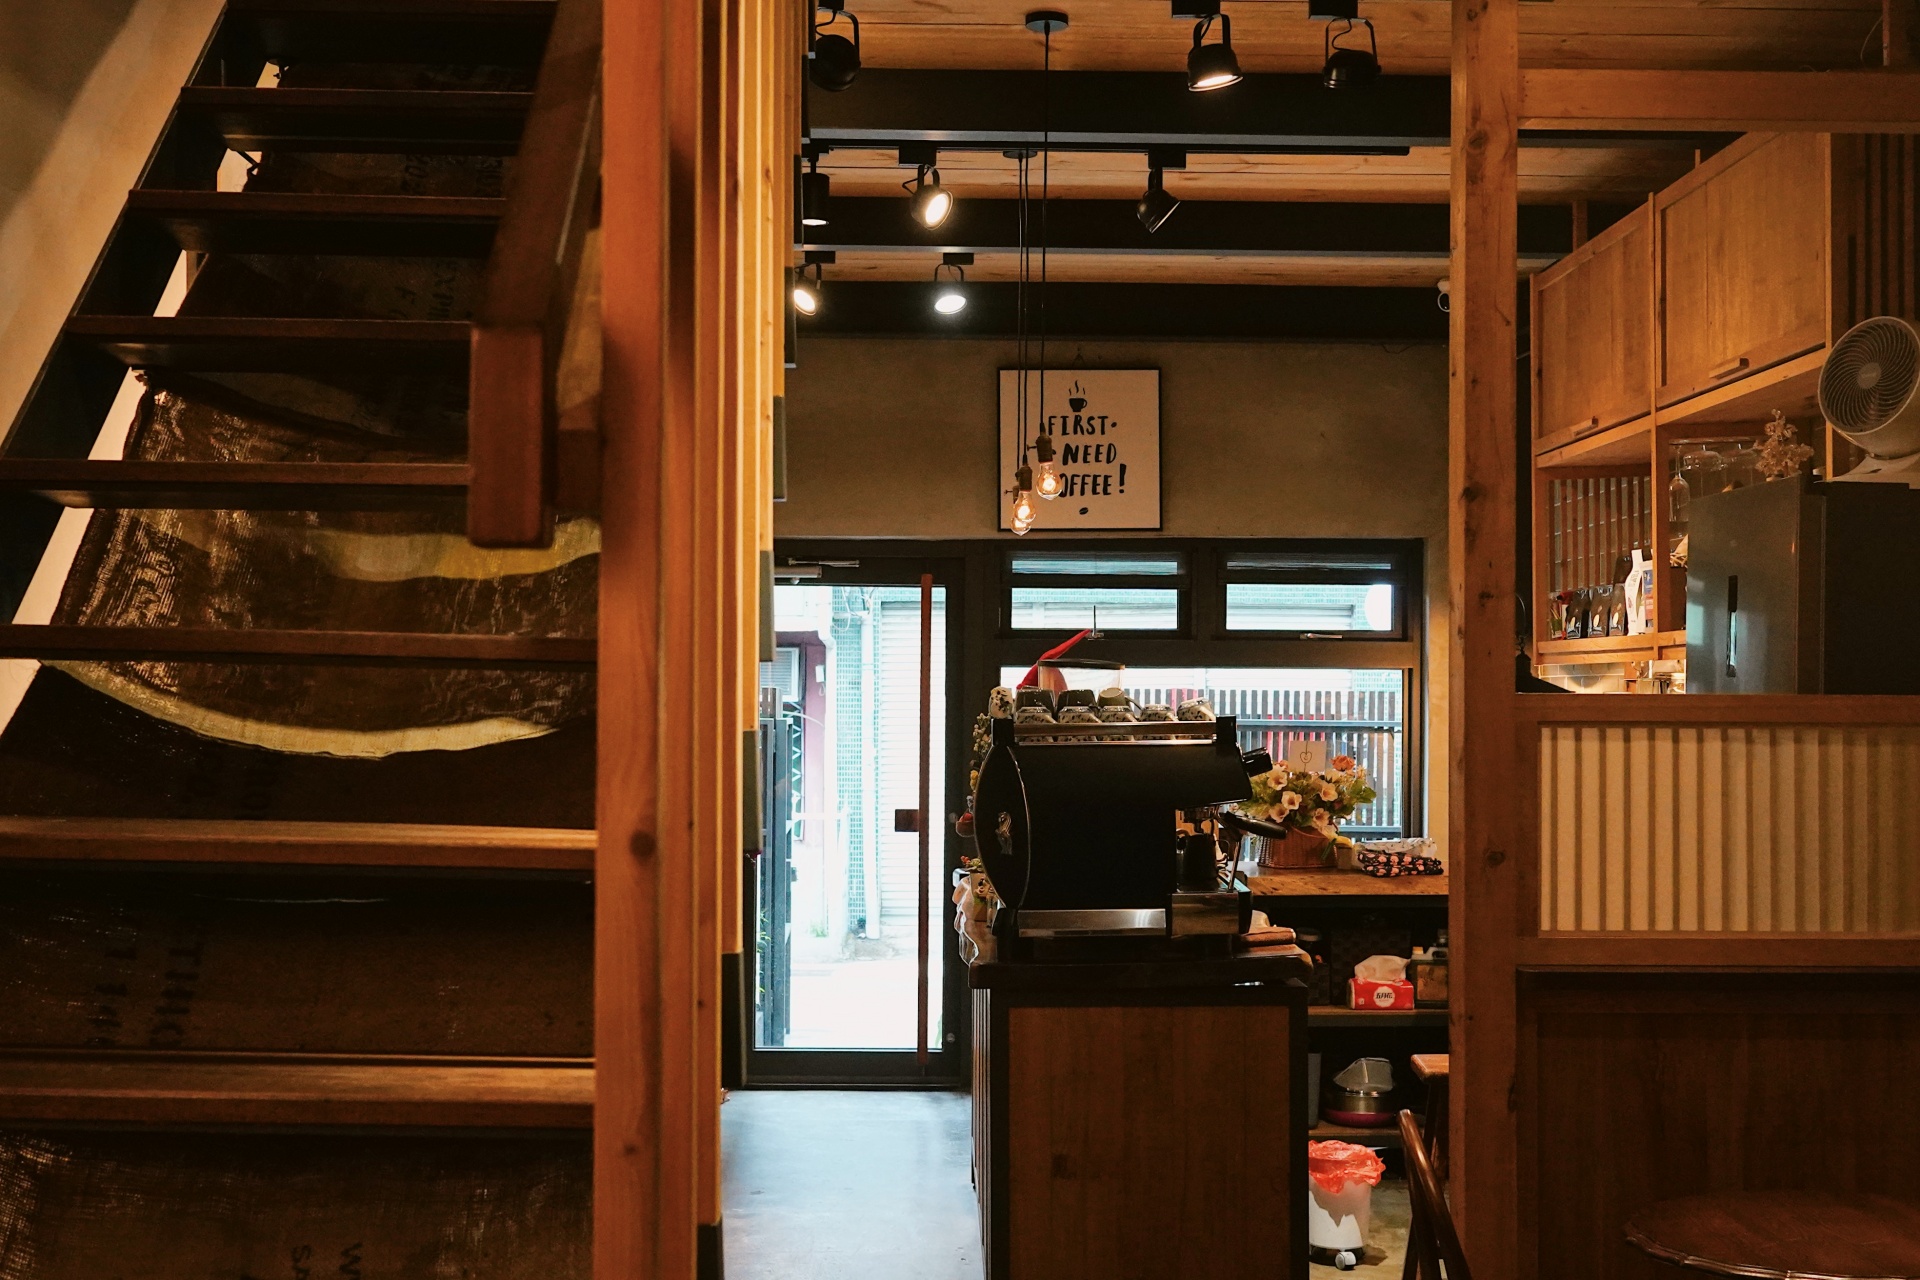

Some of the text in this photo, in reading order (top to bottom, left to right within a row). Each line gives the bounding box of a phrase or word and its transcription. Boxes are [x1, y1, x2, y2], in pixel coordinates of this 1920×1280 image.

[1048, 414, 1109, 435] FIRST
[1062, 442, 1117, 466] NEED
[1058, 463, 1127, 498] OFFEE!
